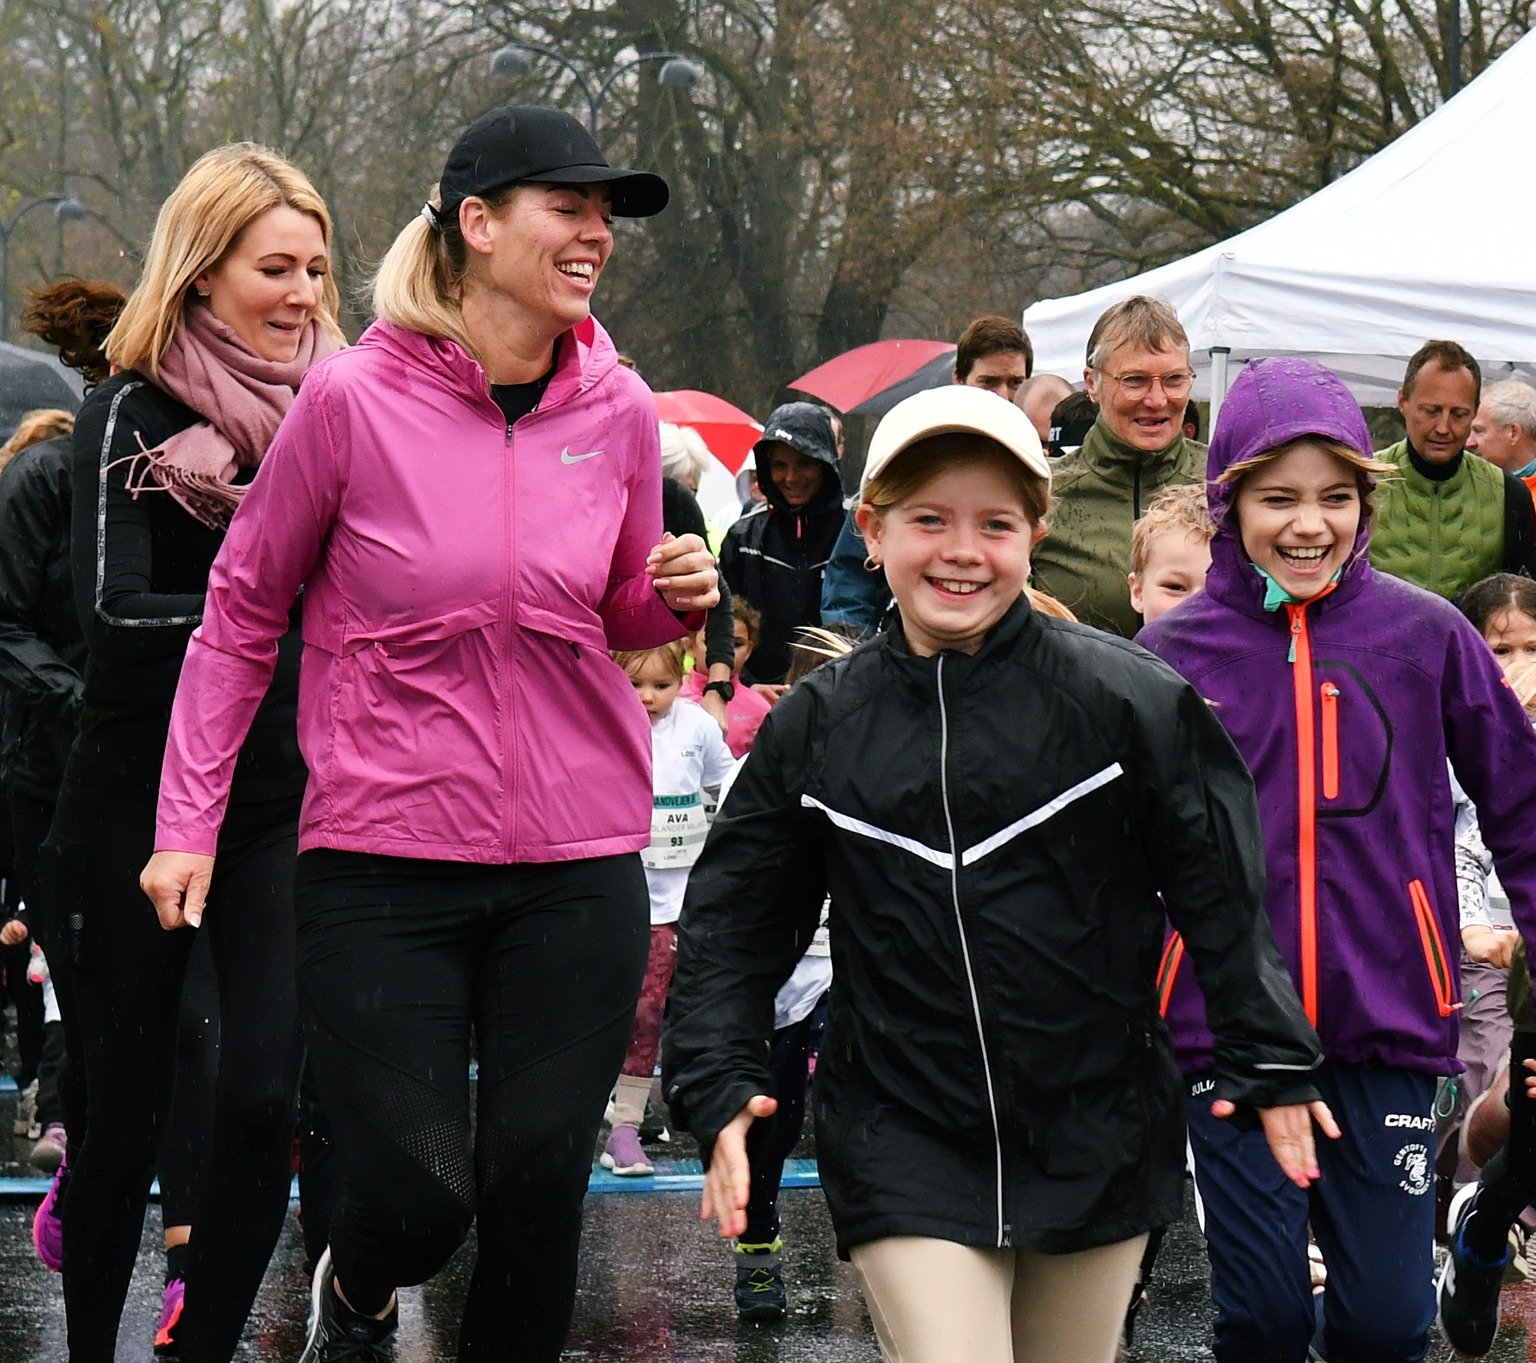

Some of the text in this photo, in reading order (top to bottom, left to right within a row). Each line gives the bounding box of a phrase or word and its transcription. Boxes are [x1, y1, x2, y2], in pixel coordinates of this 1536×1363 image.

[667, 813, 688, 823] AVA
[670, 837, 683, 846] 93
[1384, 1114, 1433, 1131] CRAFT
